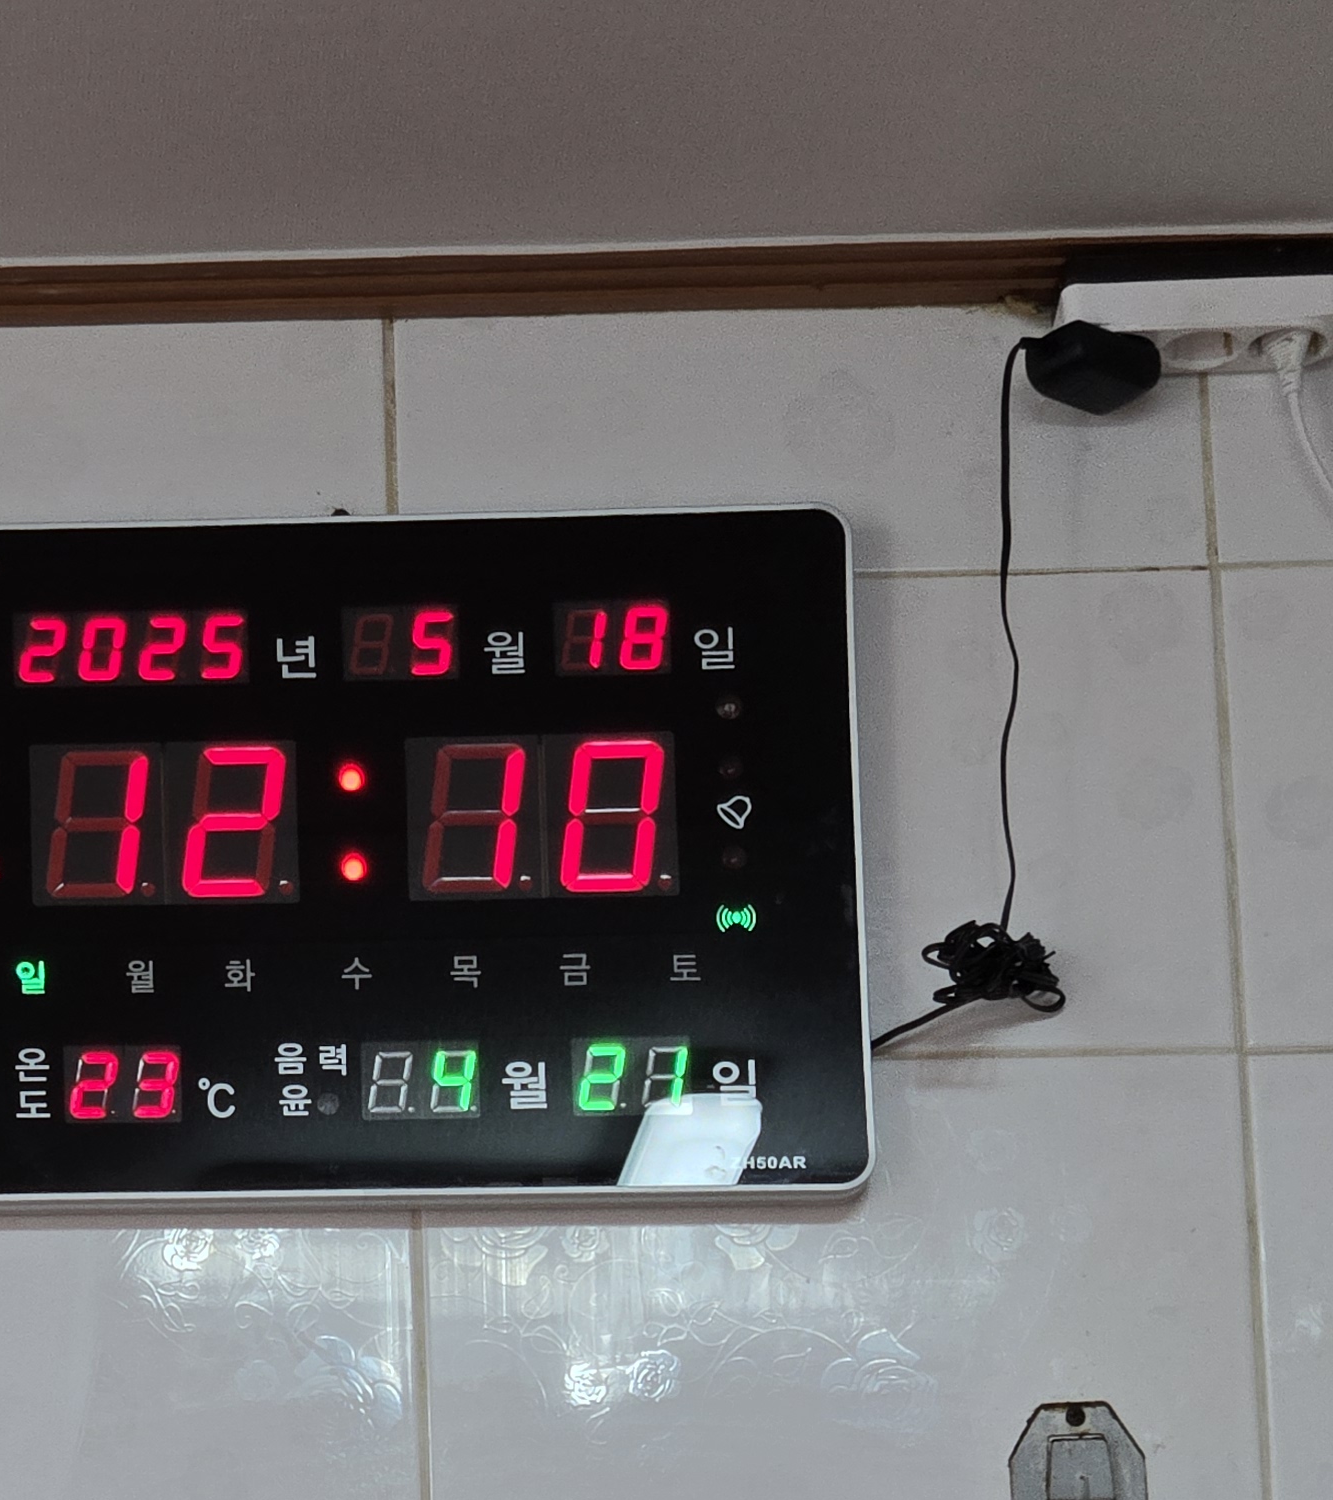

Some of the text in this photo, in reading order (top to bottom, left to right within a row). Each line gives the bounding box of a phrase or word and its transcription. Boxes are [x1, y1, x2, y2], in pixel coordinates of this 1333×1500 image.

[18, 604, 736, 683] 2025 년 5 월 18 일
[15, 953, 702, 995] 일 월 화 수 목 금 토
[14, 1047, 51, 1119] 온도
[69, 1050, 180, 1120] 23
[278, 1084, 312, 1116] 윤
[429, 1048, 479, 1114] 4
[501, 1061, 548, 1110] 월
[579, 1042, 689, 1112] 21
[711, 1058, 757, 1106] 일
